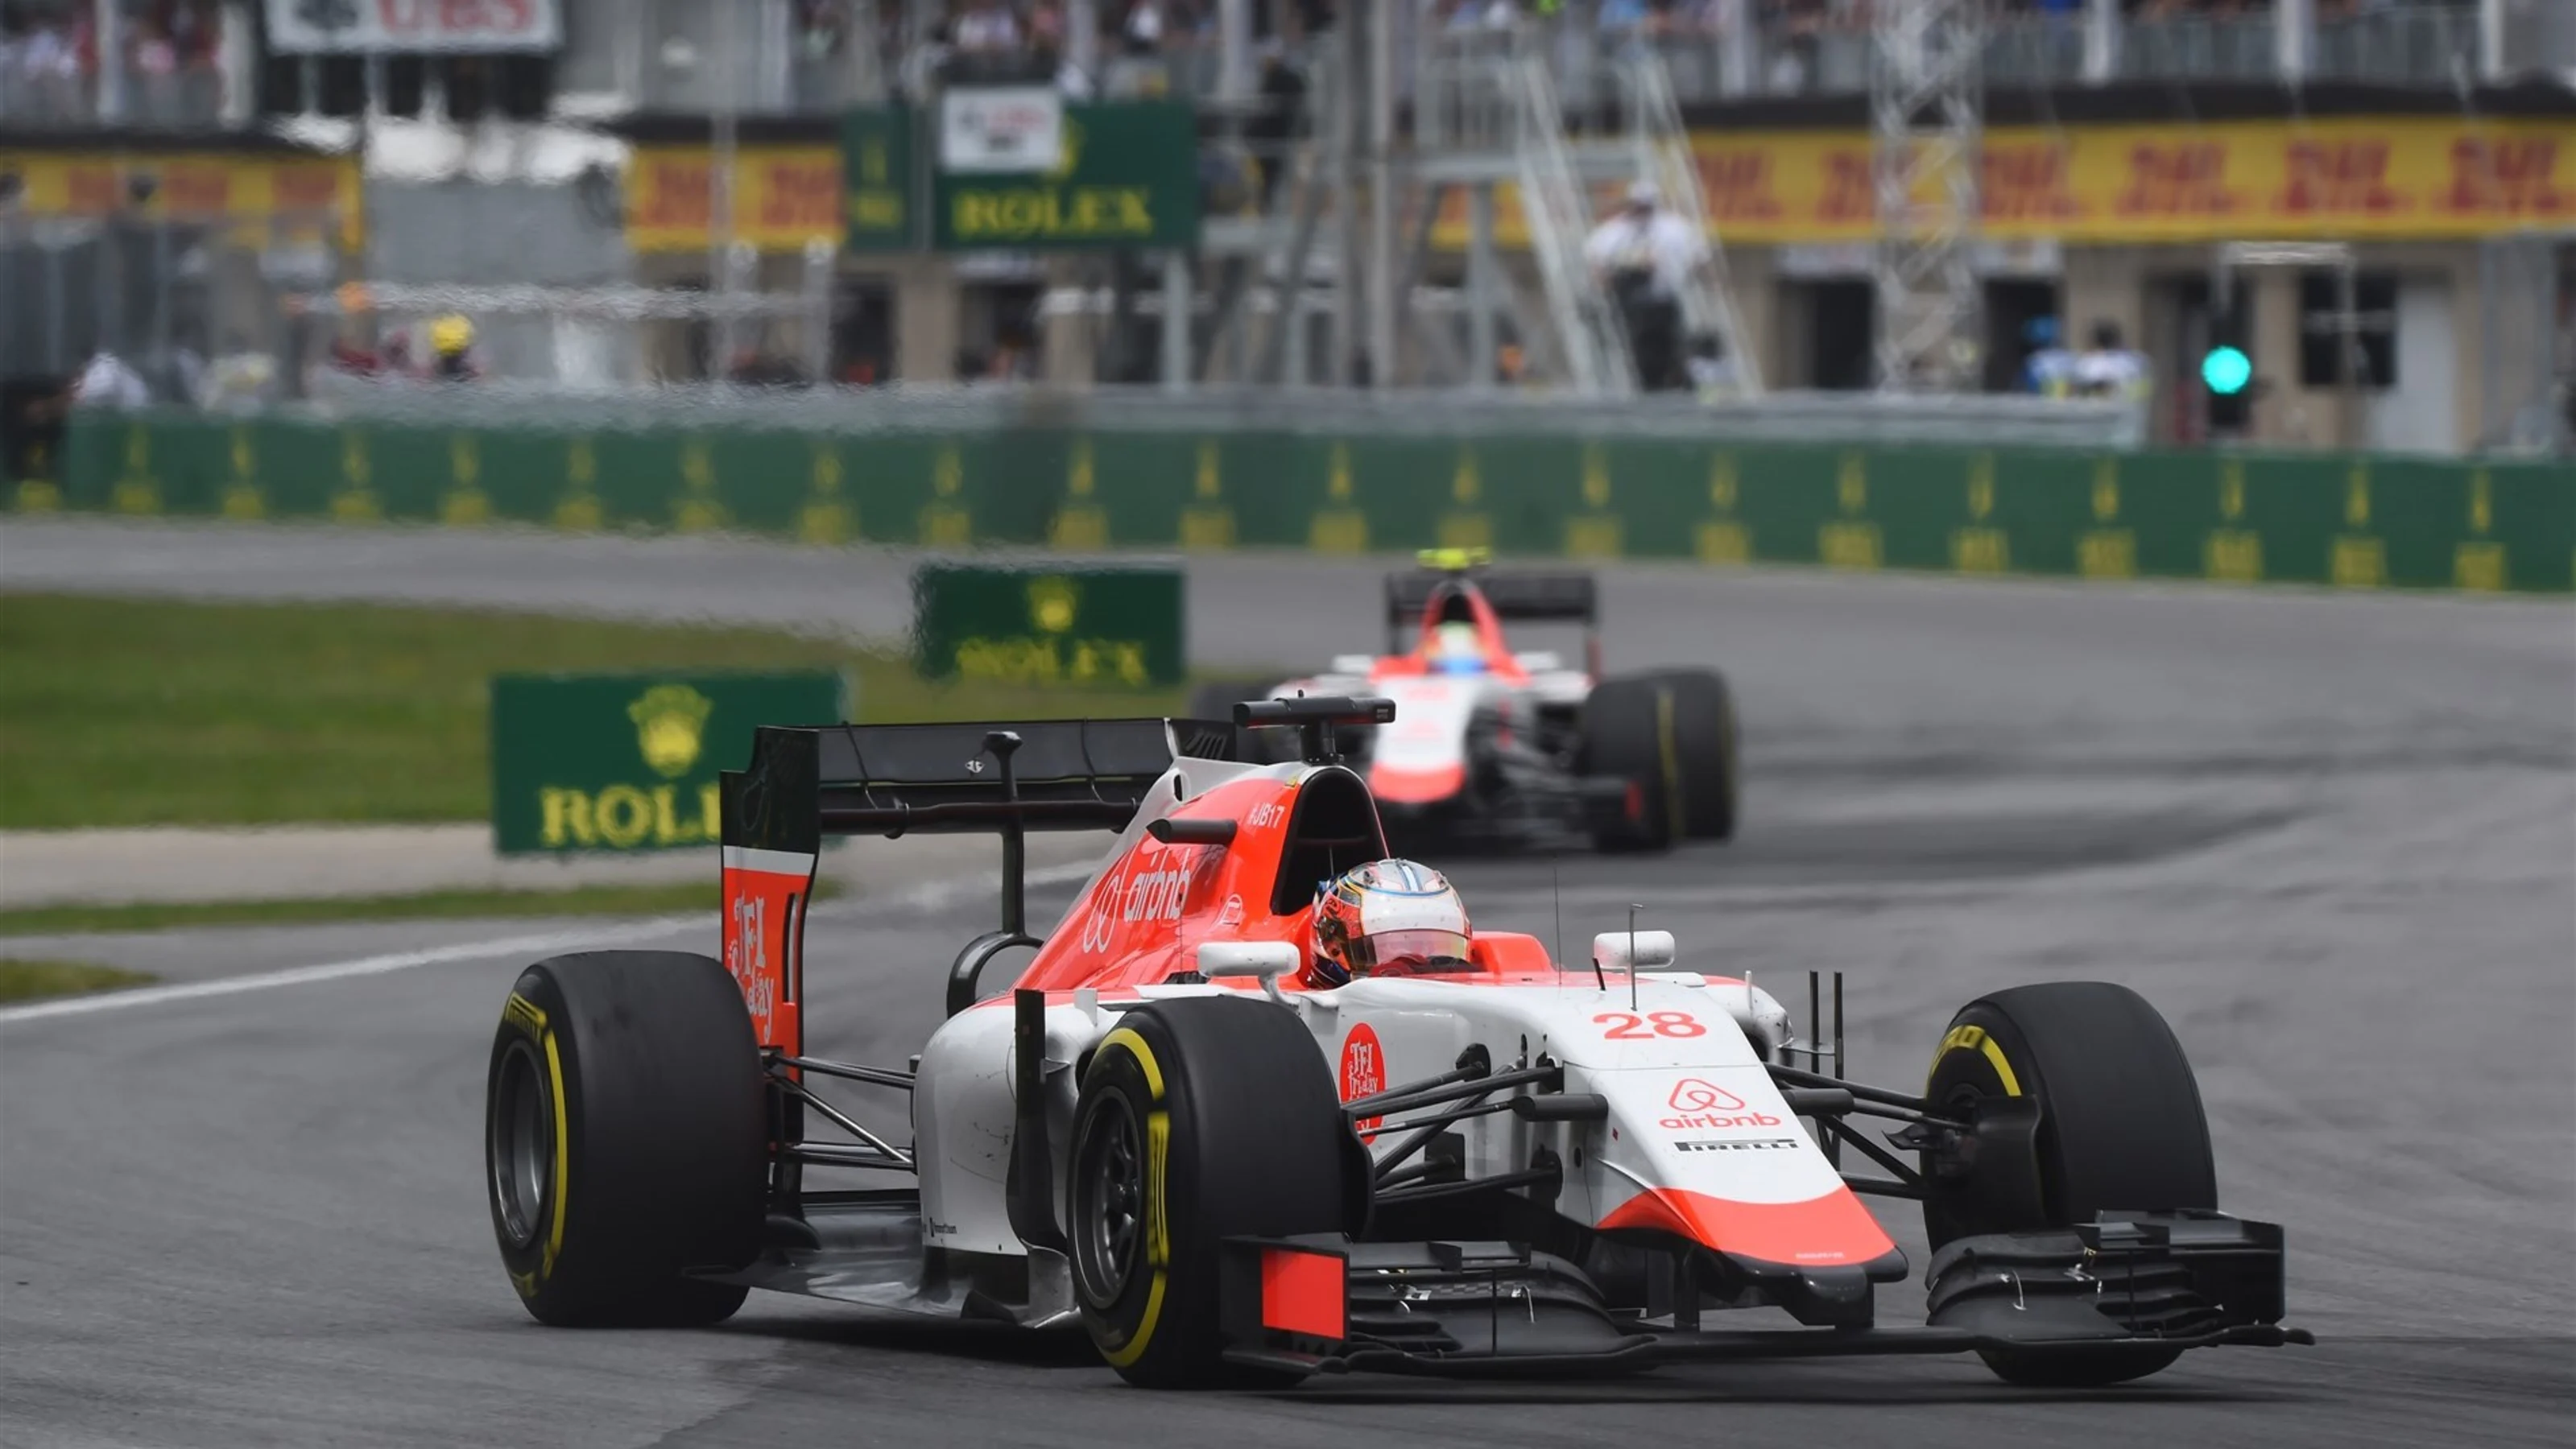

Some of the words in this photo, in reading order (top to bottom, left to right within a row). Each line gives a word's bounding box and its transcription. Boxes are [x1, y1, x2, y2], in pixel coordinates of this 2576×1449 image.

[953, 187, 1153, 235] ROLEX
[1124, 848, 1192, 921] airbnb
[1593, 1012, 1706, 1039] 28
[1350, 1039, 1373, 1075] TFI
[1659, 1113, 1781, 1129] airbnb
[1674, 1138, 1799, 1151] PIRELLI
